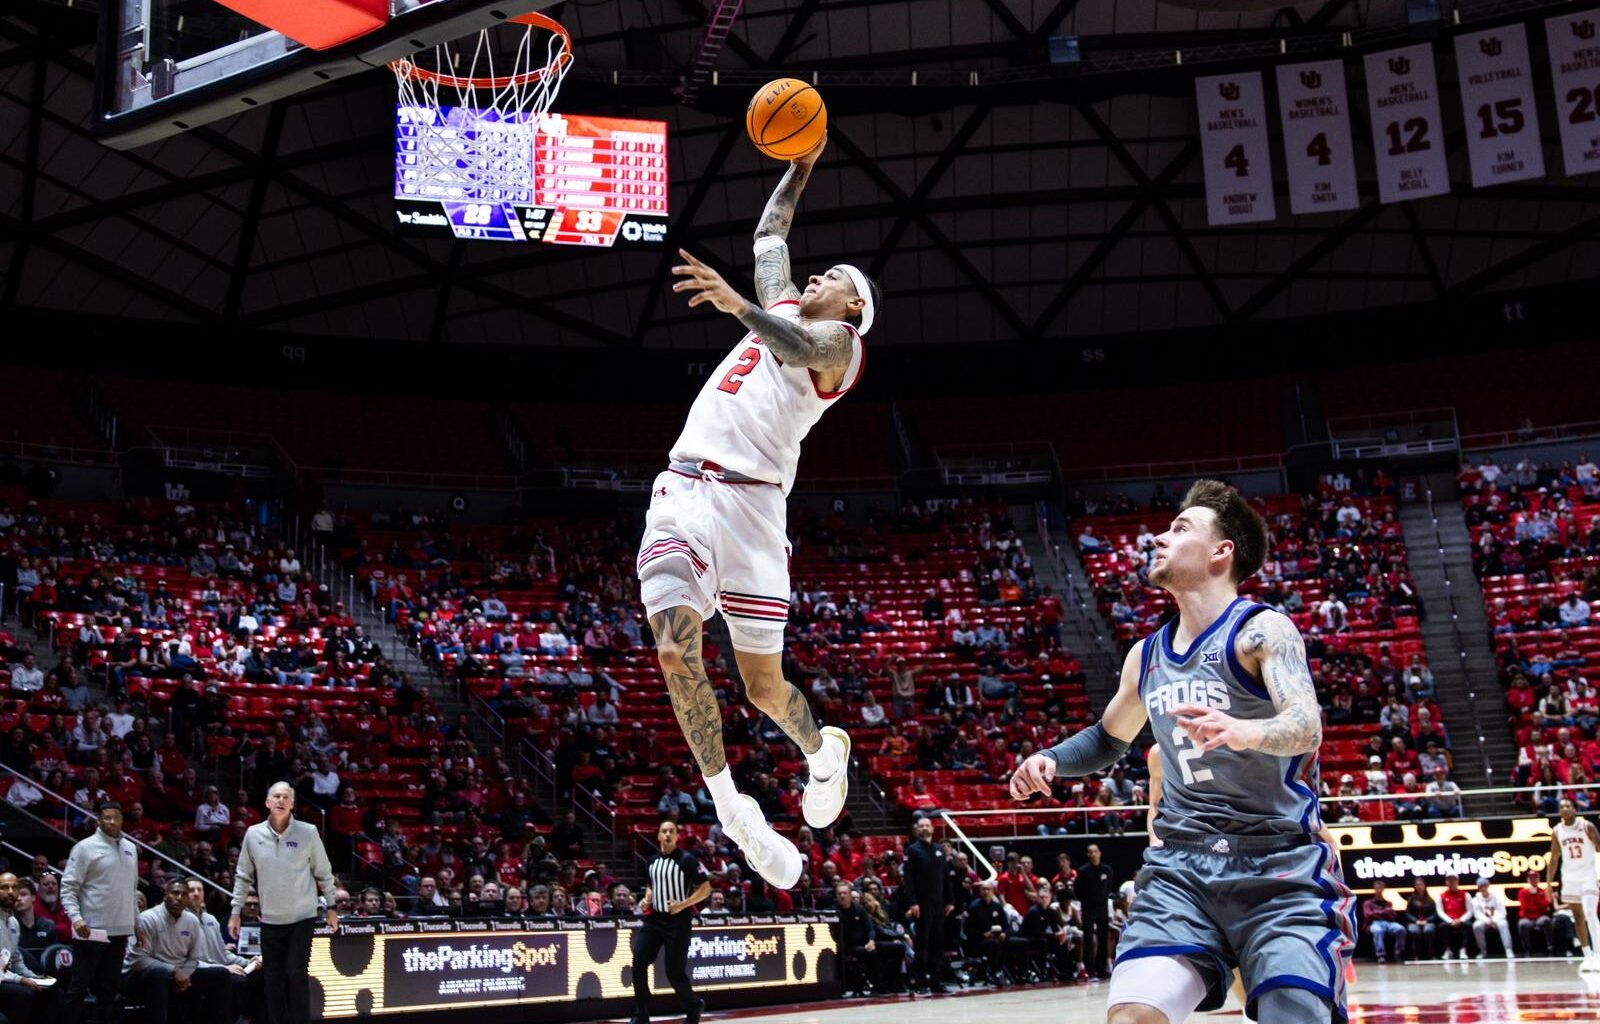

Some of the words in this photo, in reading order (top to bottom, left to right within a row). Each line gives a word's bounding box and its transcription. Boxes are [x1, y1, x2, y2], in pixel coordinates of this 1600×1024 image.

[1468, 67, 1522, 85] VOLLEYBALL
[1390, 83, 1415, 95] MEN'S
[1295, 96, 1333, 109] WOMEN'S
[1377, 91, 1430, 108] BASKETBALL
[1220, 109, 1244, 119] MEN'S
[1289, 106, 1340, 119] BASKETBALL
[1477, 98, 1524, 139] 15
[1208, 118, 1257, 131] BASKETBALL
[1386, 117, 1431, 155] 12
[1307, 132, 1331, 165] 4
[1496, 151, 1515, 162] KIM
[1224, 144, 1248, 177] 4
[717, 347, 761, 395] 2
[834, 500, 845, 511] R
[1145, 680, 1231, 716] FROGS
[1172, 725, 1215, 785] 2
[1569, 845, 1582, 859] 13
[402, 941, 558, 973] theParkingSpot
